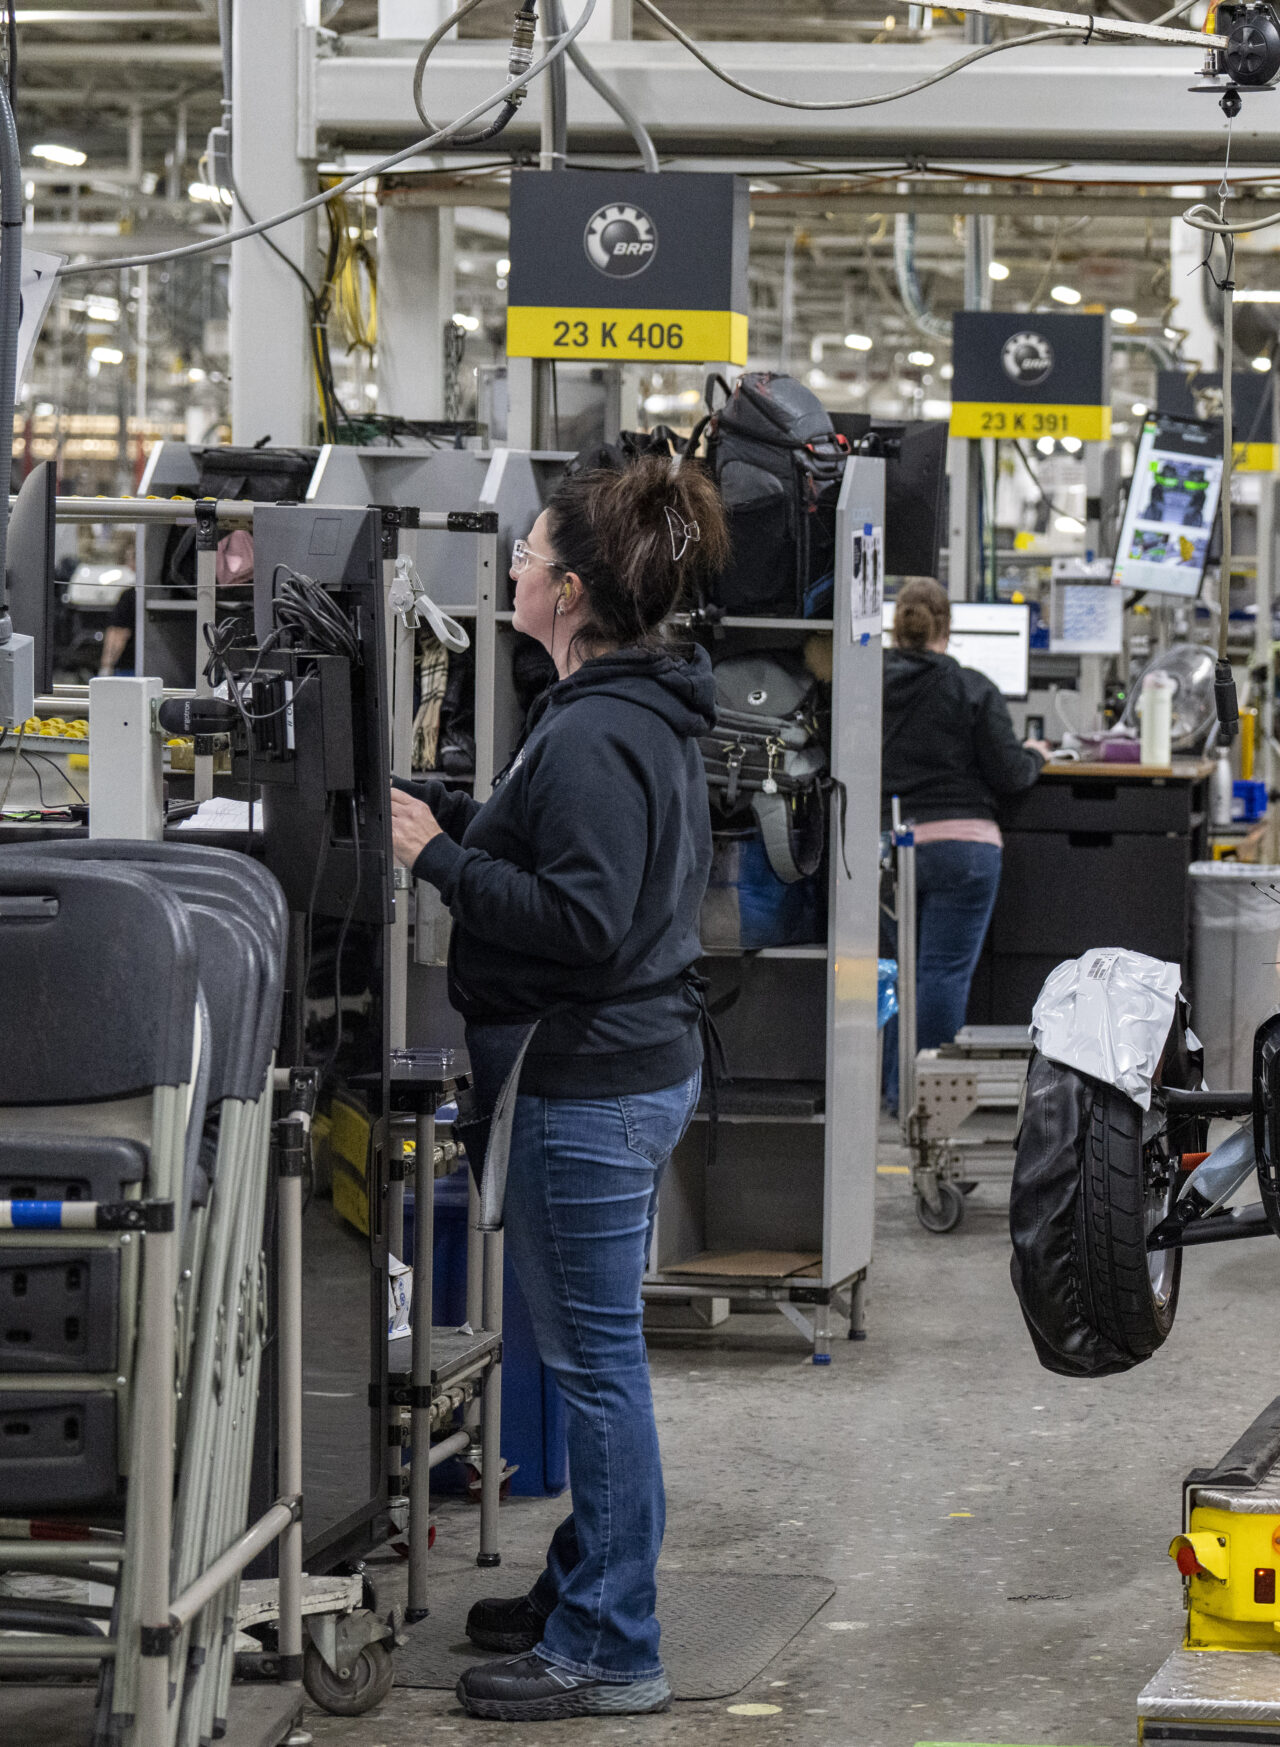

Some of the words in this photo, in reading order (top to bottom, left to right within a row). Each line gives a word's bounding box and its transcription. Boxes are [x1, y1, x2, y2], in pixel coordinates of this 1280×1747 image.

[613, 242, 654, 256] BRP
[553, 321, 589, 347] 23
[601, 322, 617, 348] K
[627, 323, 683, 349] 406
[981, 412, 1006, 431] 23
[1014, 413, 1026, 431] K
[1033, 413, 1069, 432] 391
